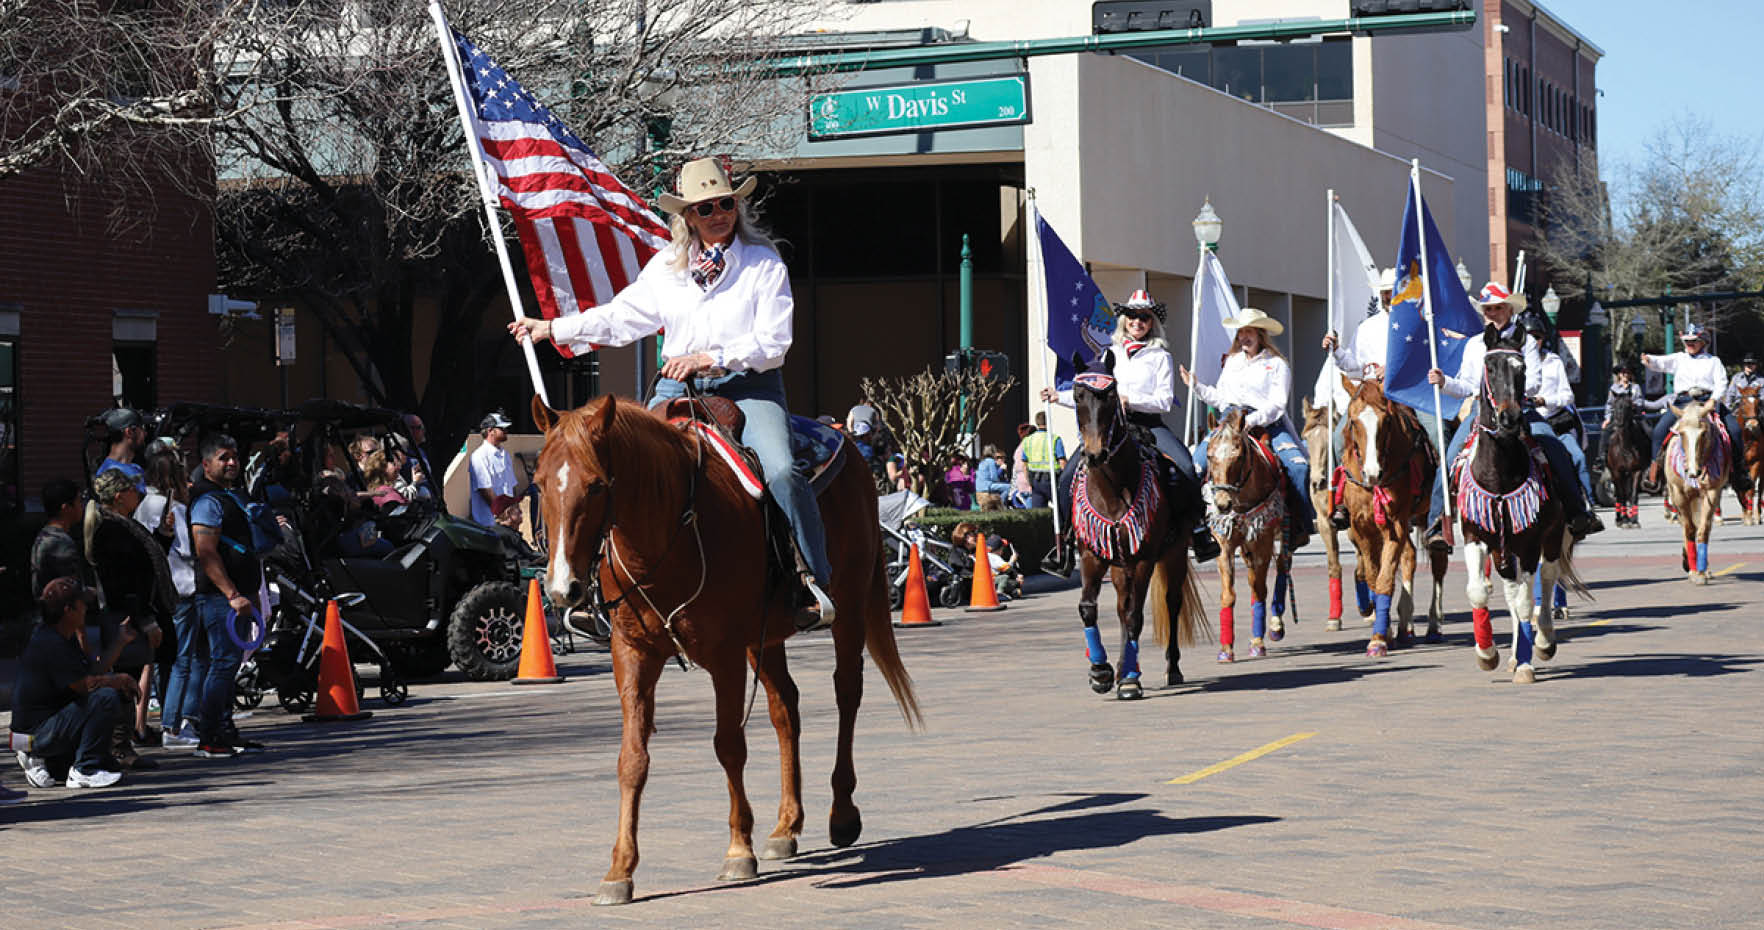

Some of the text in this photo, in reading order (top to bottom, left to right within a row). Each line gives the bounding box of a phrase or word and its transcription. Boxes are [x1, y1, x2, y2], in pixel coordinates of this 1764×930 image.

[866, 89, 967, 119] W Davis St
[998, 105, 1015, 117] 200
